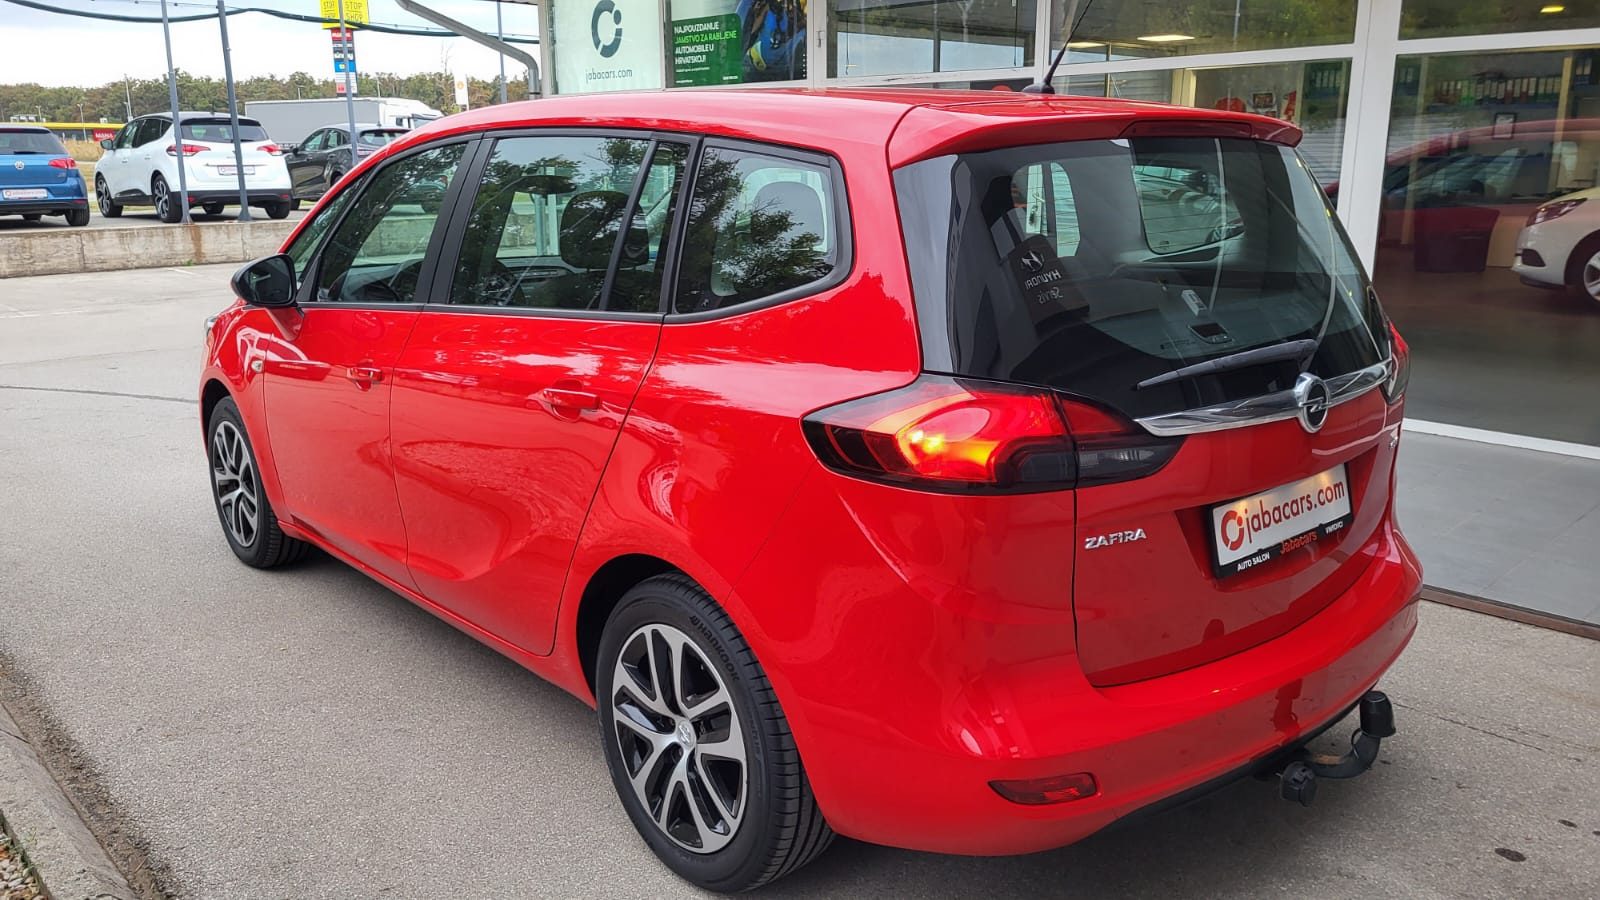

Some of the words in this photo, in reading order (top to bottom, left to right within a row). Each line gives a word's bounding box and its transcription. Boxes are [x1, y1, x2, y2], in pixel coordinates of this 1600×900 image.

[345, 2, 363, 10] STOP
[709, 30, 737, 41] RABLJENE
[585, 67, 633, 84] jabacars.com
[1244, 481, 1345, 544] jabacars.com
[1085, 528, 1147, 550] ZAFIRA
[1237, 557, 1253, 572] AUTO
[1252, 551, 1270, 566] SALON
[1280, 531, 1317, 554] Jabacars
